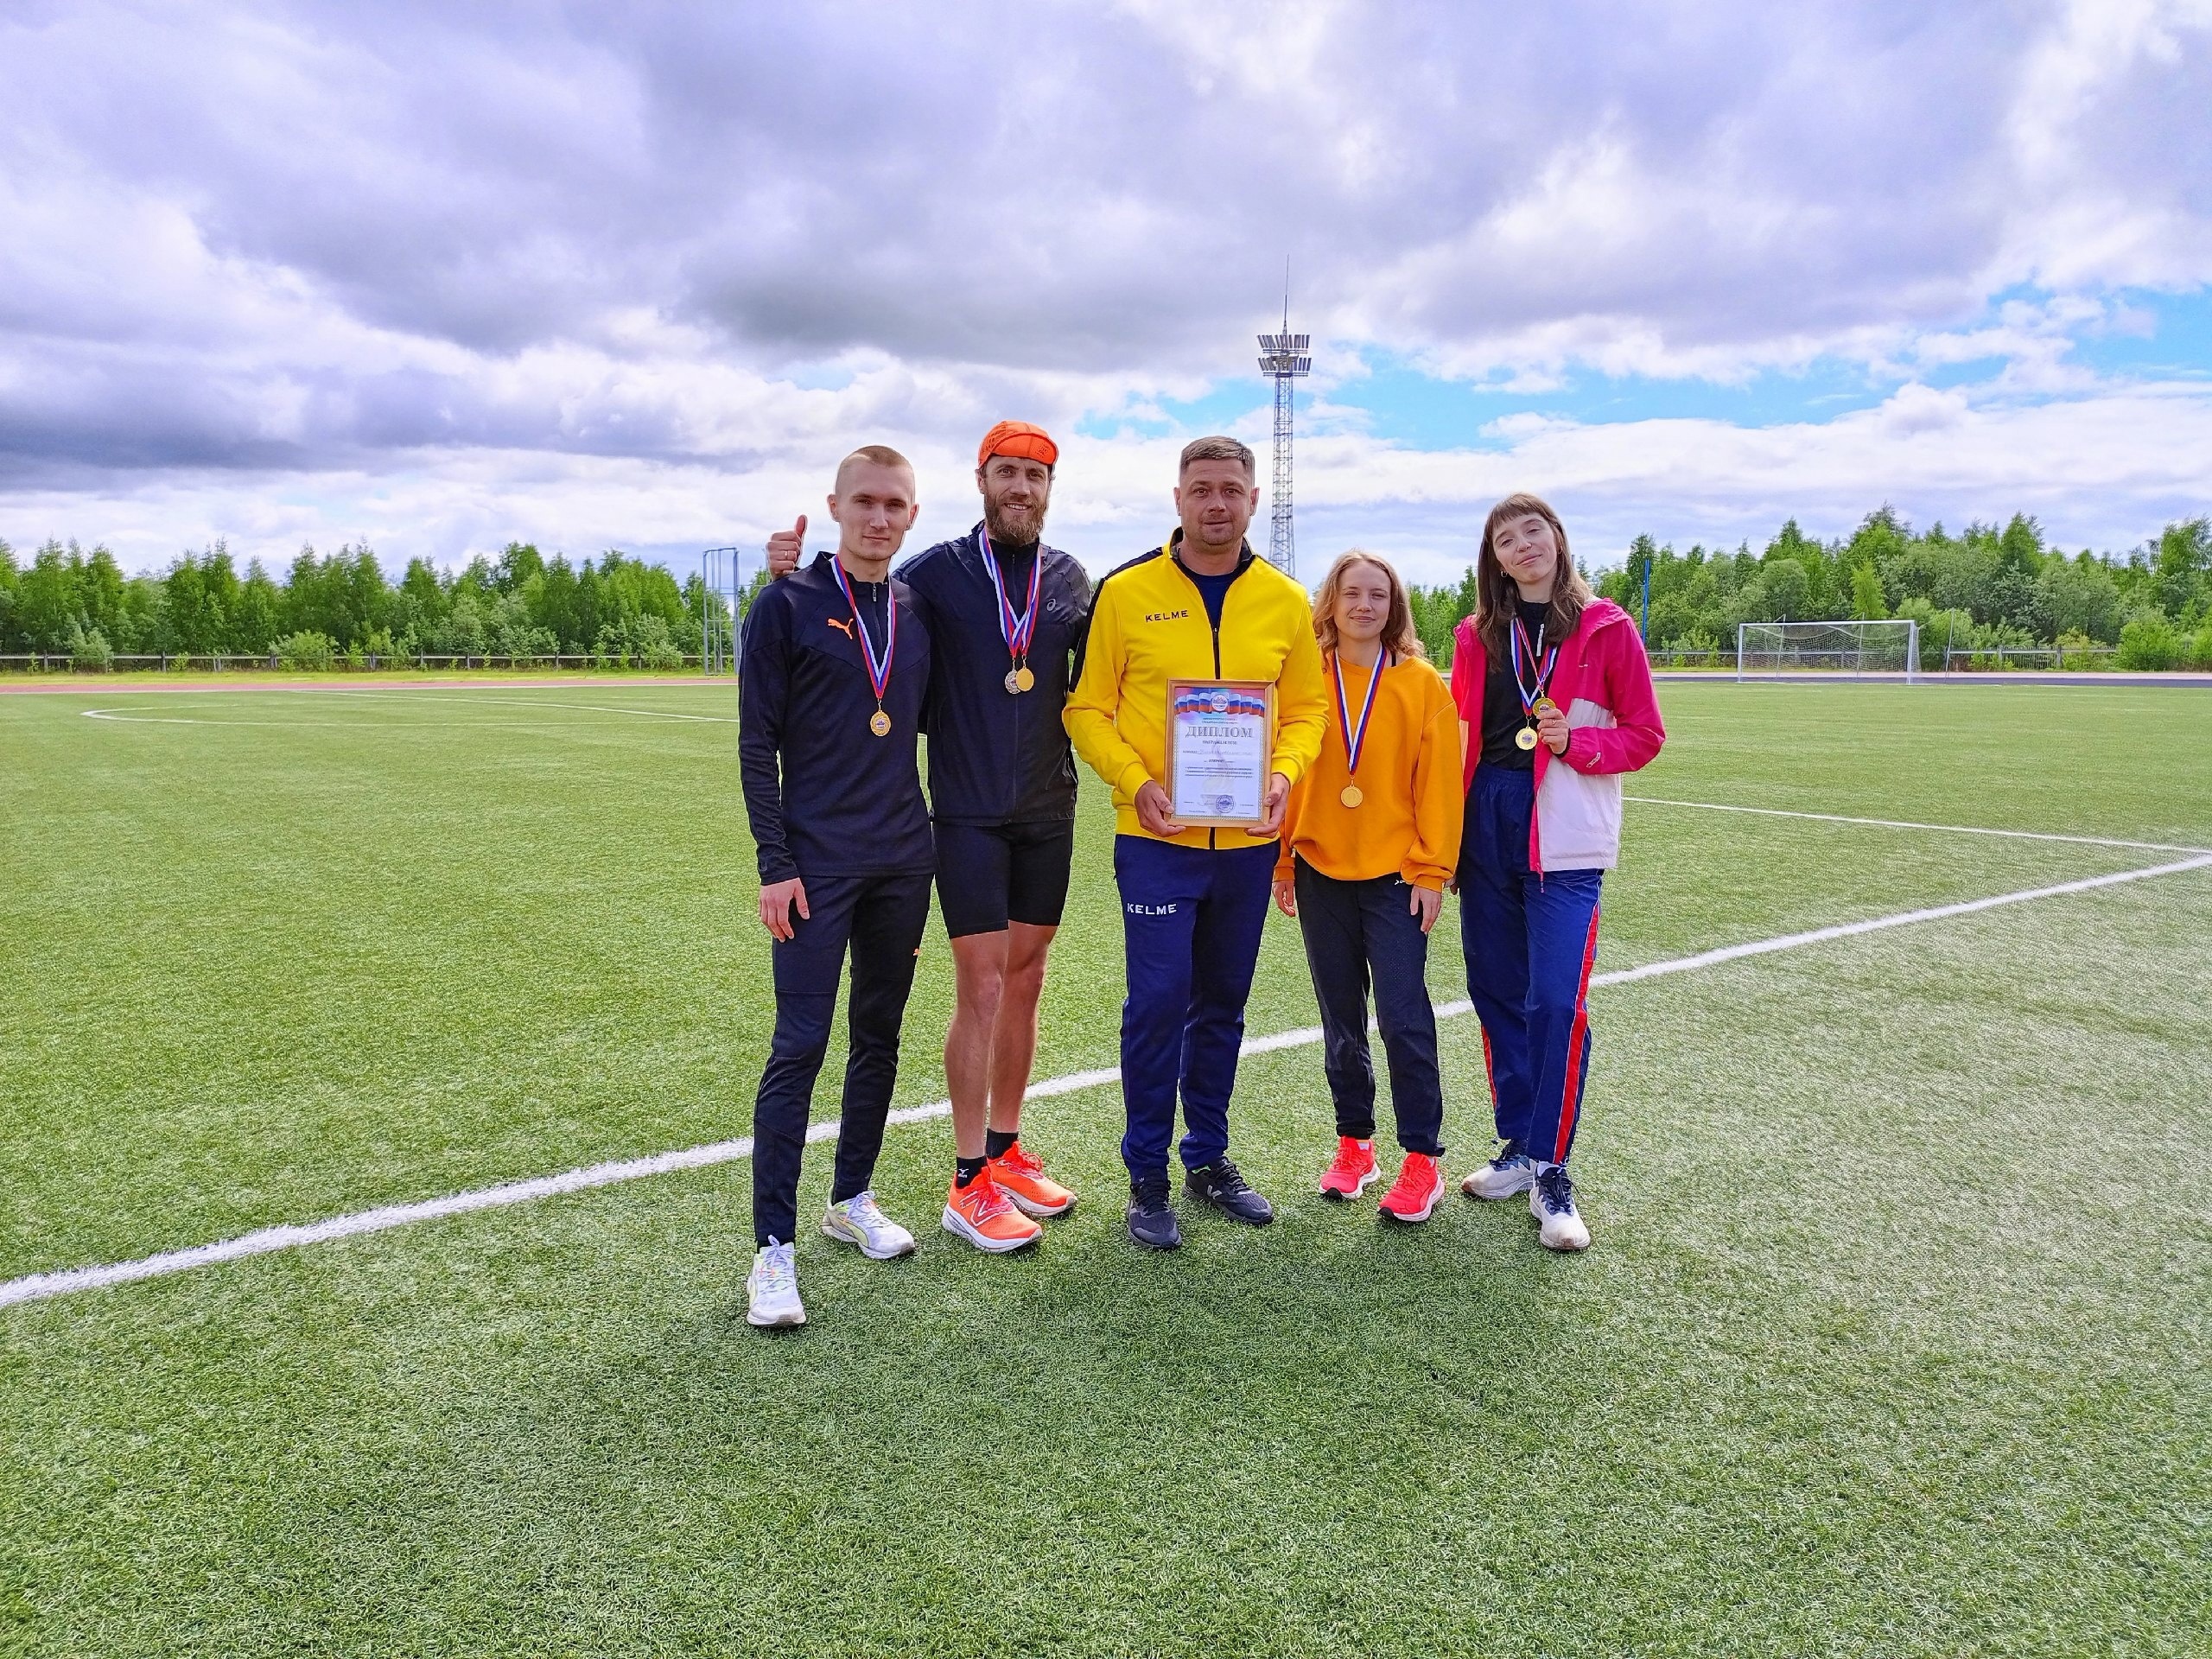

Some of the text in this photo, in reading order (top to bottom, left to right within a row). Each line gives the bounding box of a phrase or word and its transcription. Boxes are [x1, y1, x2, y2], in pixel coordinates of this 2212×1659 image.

[1145, 609, 1189, 623] KELME
[1185, 726, 1252, 738] ДИПЛОМ
[1127, 902, 1177, 915] KELME
